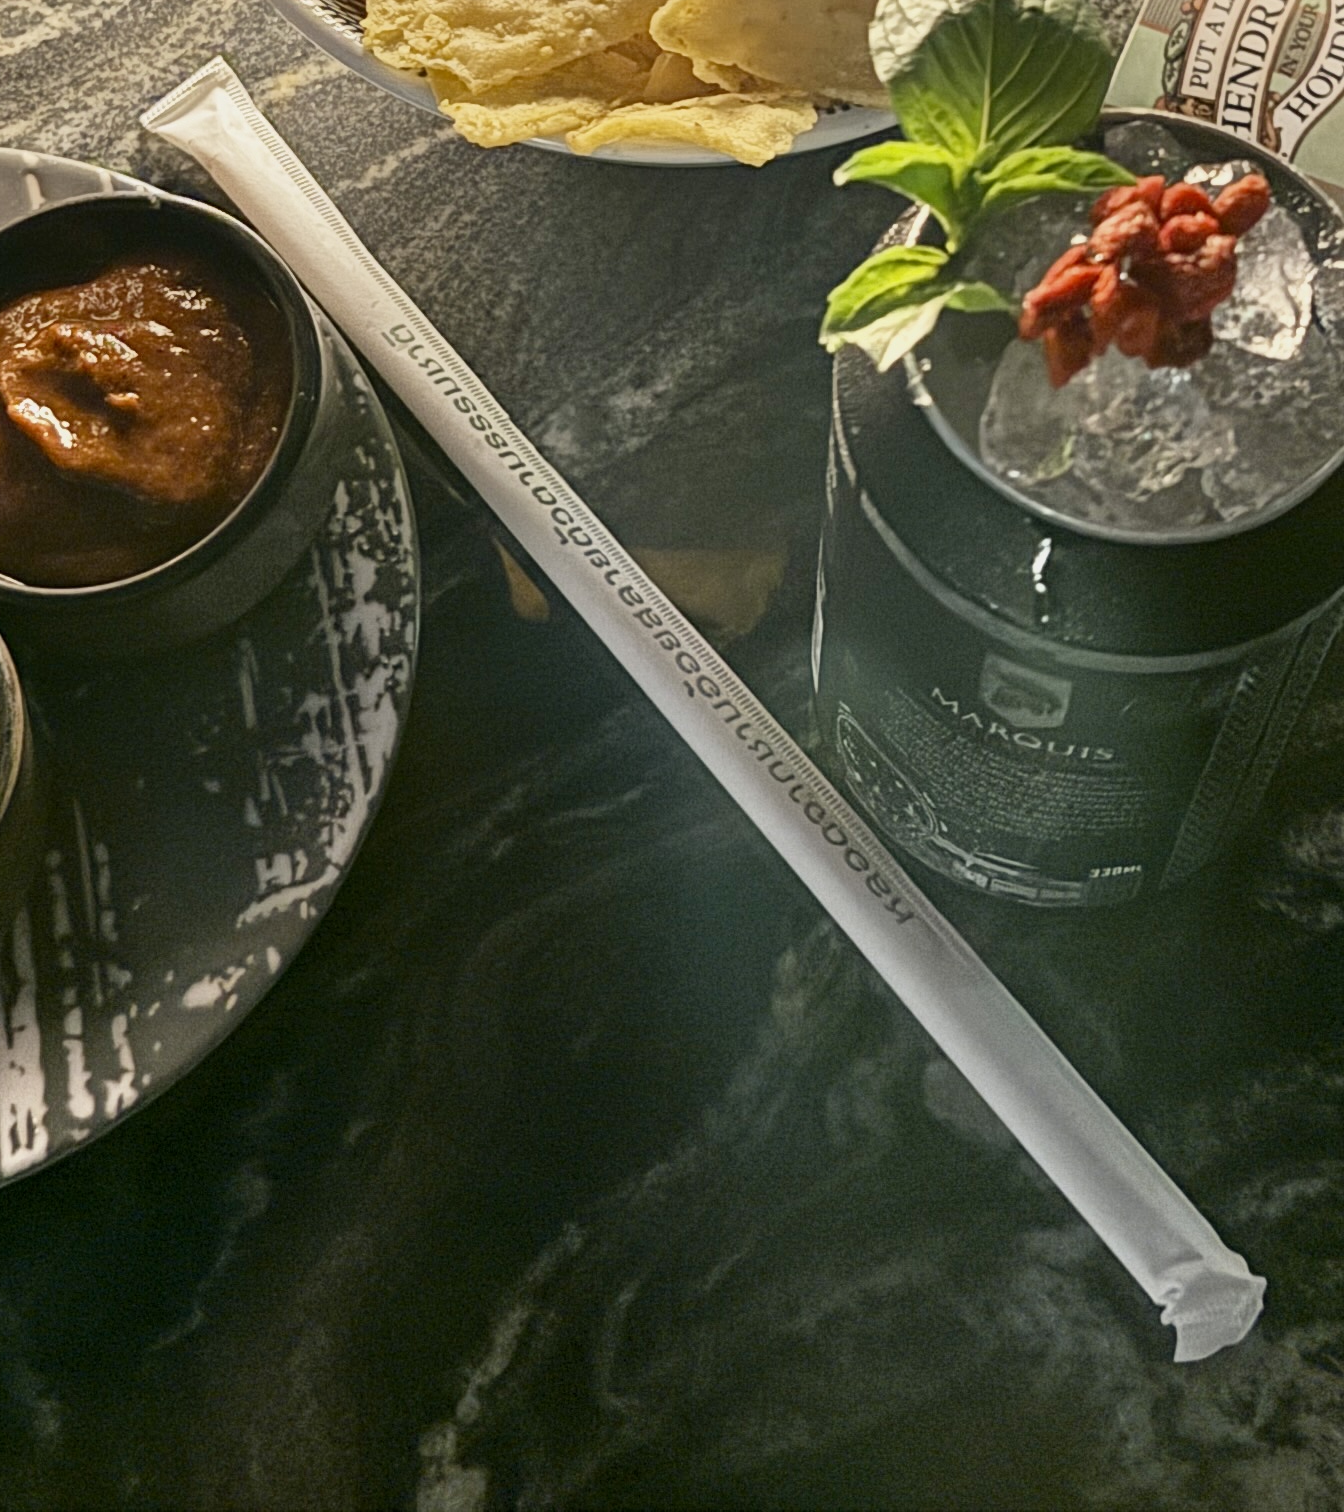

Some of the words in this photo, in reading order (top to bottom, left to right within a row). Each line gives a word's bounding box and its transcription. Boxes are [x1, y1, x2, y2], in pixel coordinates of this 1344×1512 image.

[1189, 39, 1218, 91] PUT
[1203, 20, 1226, 37] A
[1276, 53, 1299, 78] IN
[1291, 3, 1320, 50] YOUR
[381, 322, 912, 927] หลอดจากชานอ้อยสลายตัวตามธรรมชาติ
[931, 687, 1115, 761] MARQUIS
